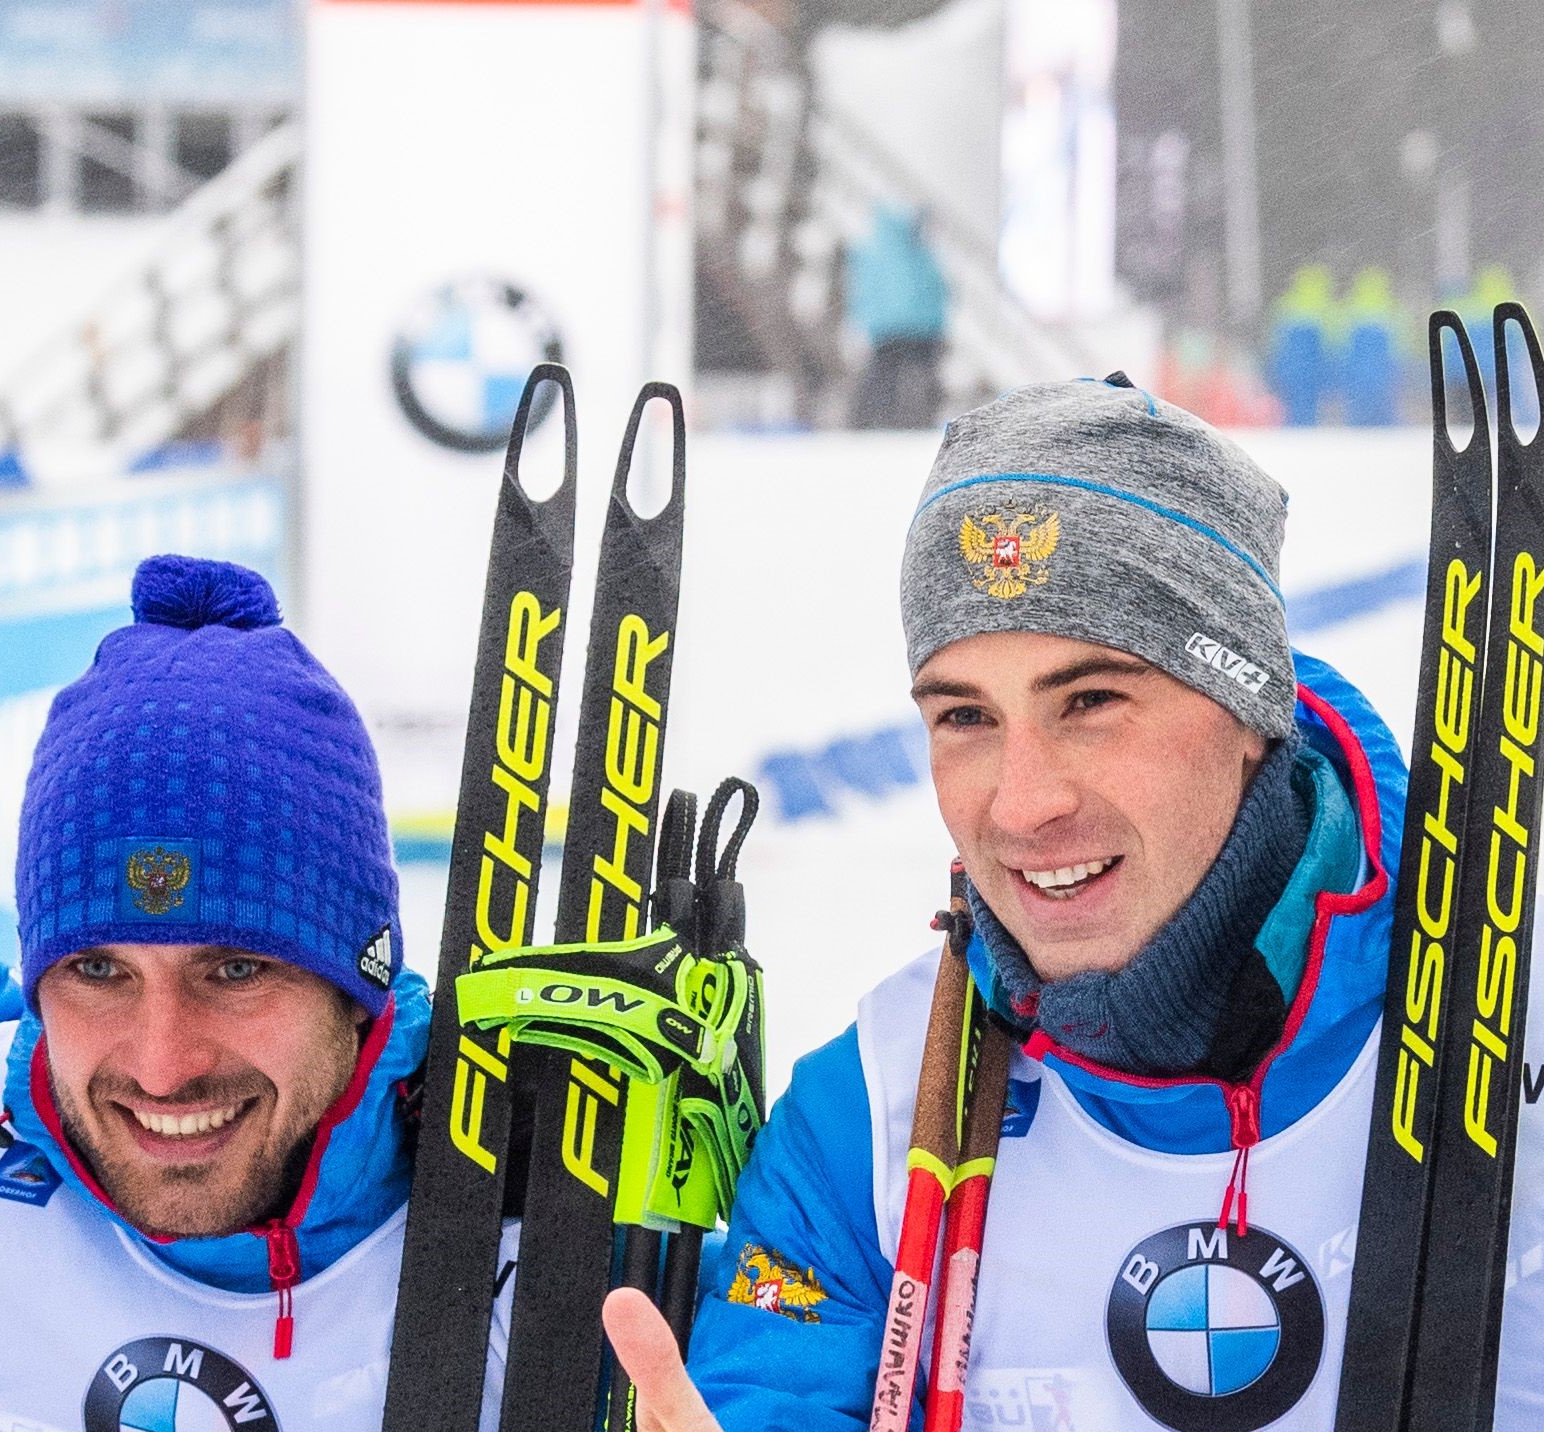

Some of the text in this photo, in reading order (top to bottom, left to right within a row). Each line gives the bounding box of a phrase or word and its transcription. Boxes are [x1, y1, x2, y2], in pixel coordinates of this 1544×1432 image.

[450, 590, 561, 1175] FICHER
[1392, 558, 1482, 1163] FISCHER
[539, 984, 646, 1014] OW
[1122, 1227, 1305, 1293] BMW
[106, 1342, 267, 1426] BMW
